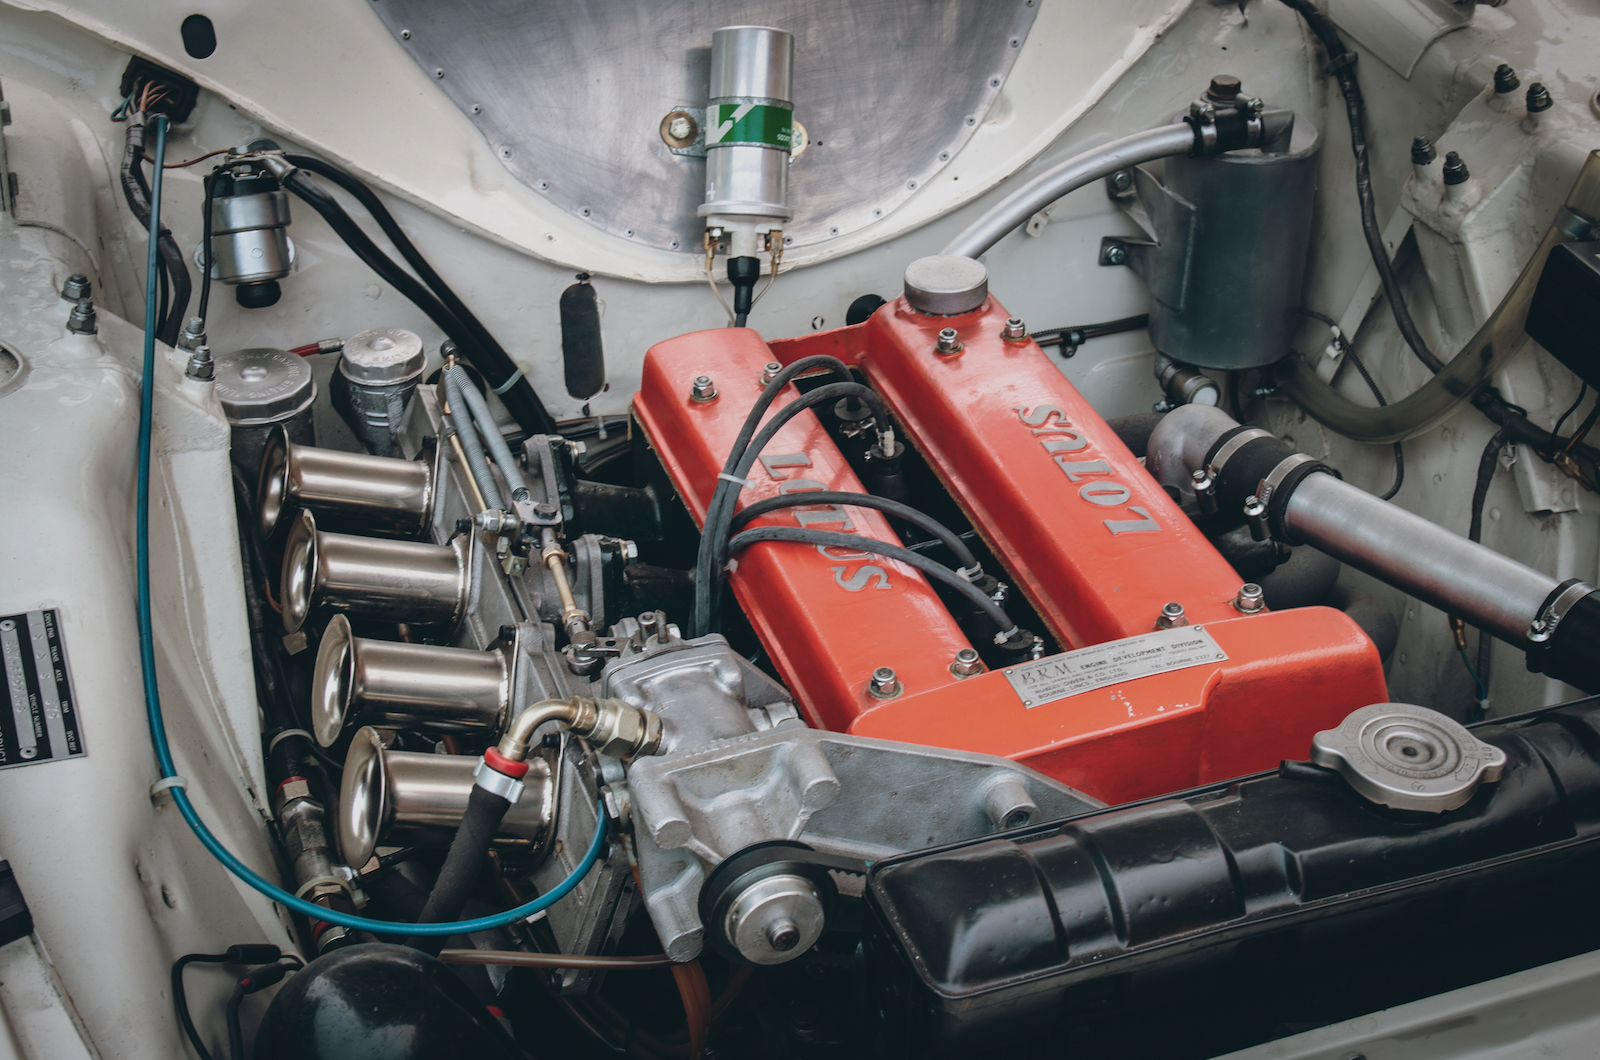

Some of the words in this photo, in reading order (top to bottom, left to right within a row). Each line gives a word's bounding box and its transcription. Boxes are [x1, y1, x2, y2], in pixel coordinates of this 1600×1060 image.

[272, 354, 300, 378] CASTROL
[248, 379, 295, 398] GIRLING
[1013, 404, 1163, 536] LOTUS
[1080, 659, 1109, 670] ENGINE
[1112, 646, 1166, 662] DEVELOPMENT
[1170, 639, 1204, 650] DIVISION
[1166, 657, 1192, 667] BOURNE
[54, 668, 63, 682] AXLE
[61, 700, 70, 714] TRIM
[1063, 677, 1086, 686] OWEN
[29, 692, 39, 714] VEHICLE
[33, 714, 43, 738] NUMBER
